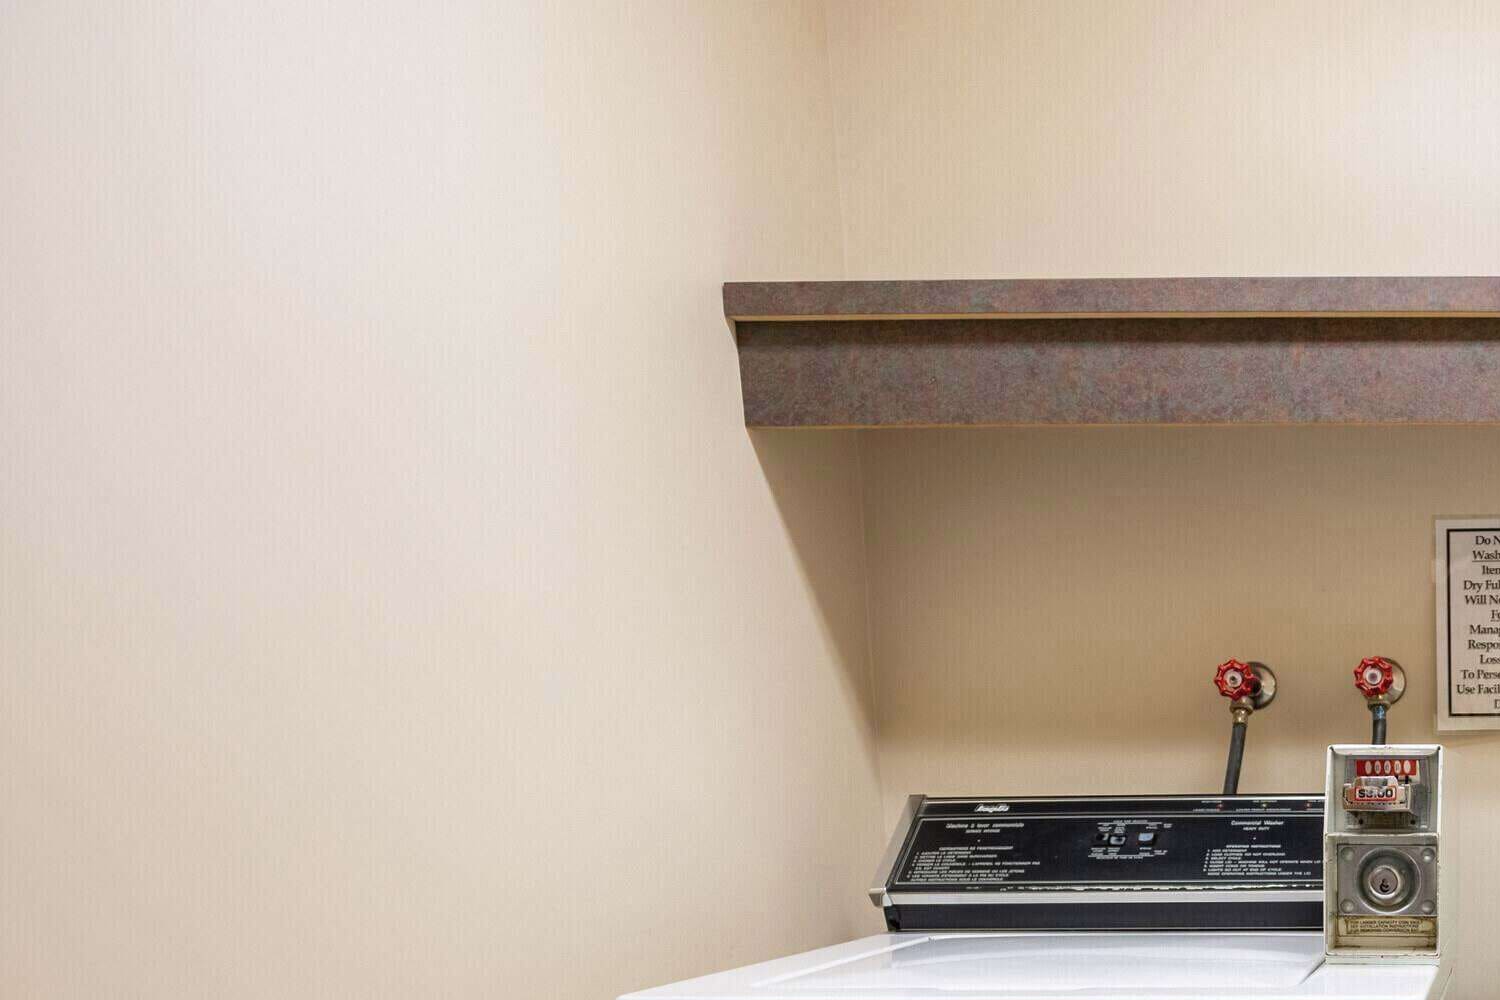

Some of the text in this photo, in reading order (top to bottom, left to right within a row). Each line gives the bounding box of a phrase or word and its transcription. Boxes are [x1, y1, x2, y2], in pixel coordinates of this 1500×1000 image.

[1475, 535, 1491, 545] Do
[1463, 580, 1482, 591] Dry
[1465, 595, 1487, 605] Will
[1461, 670, 1475, 680] To
[1456, 685, 1476, 695] Use
